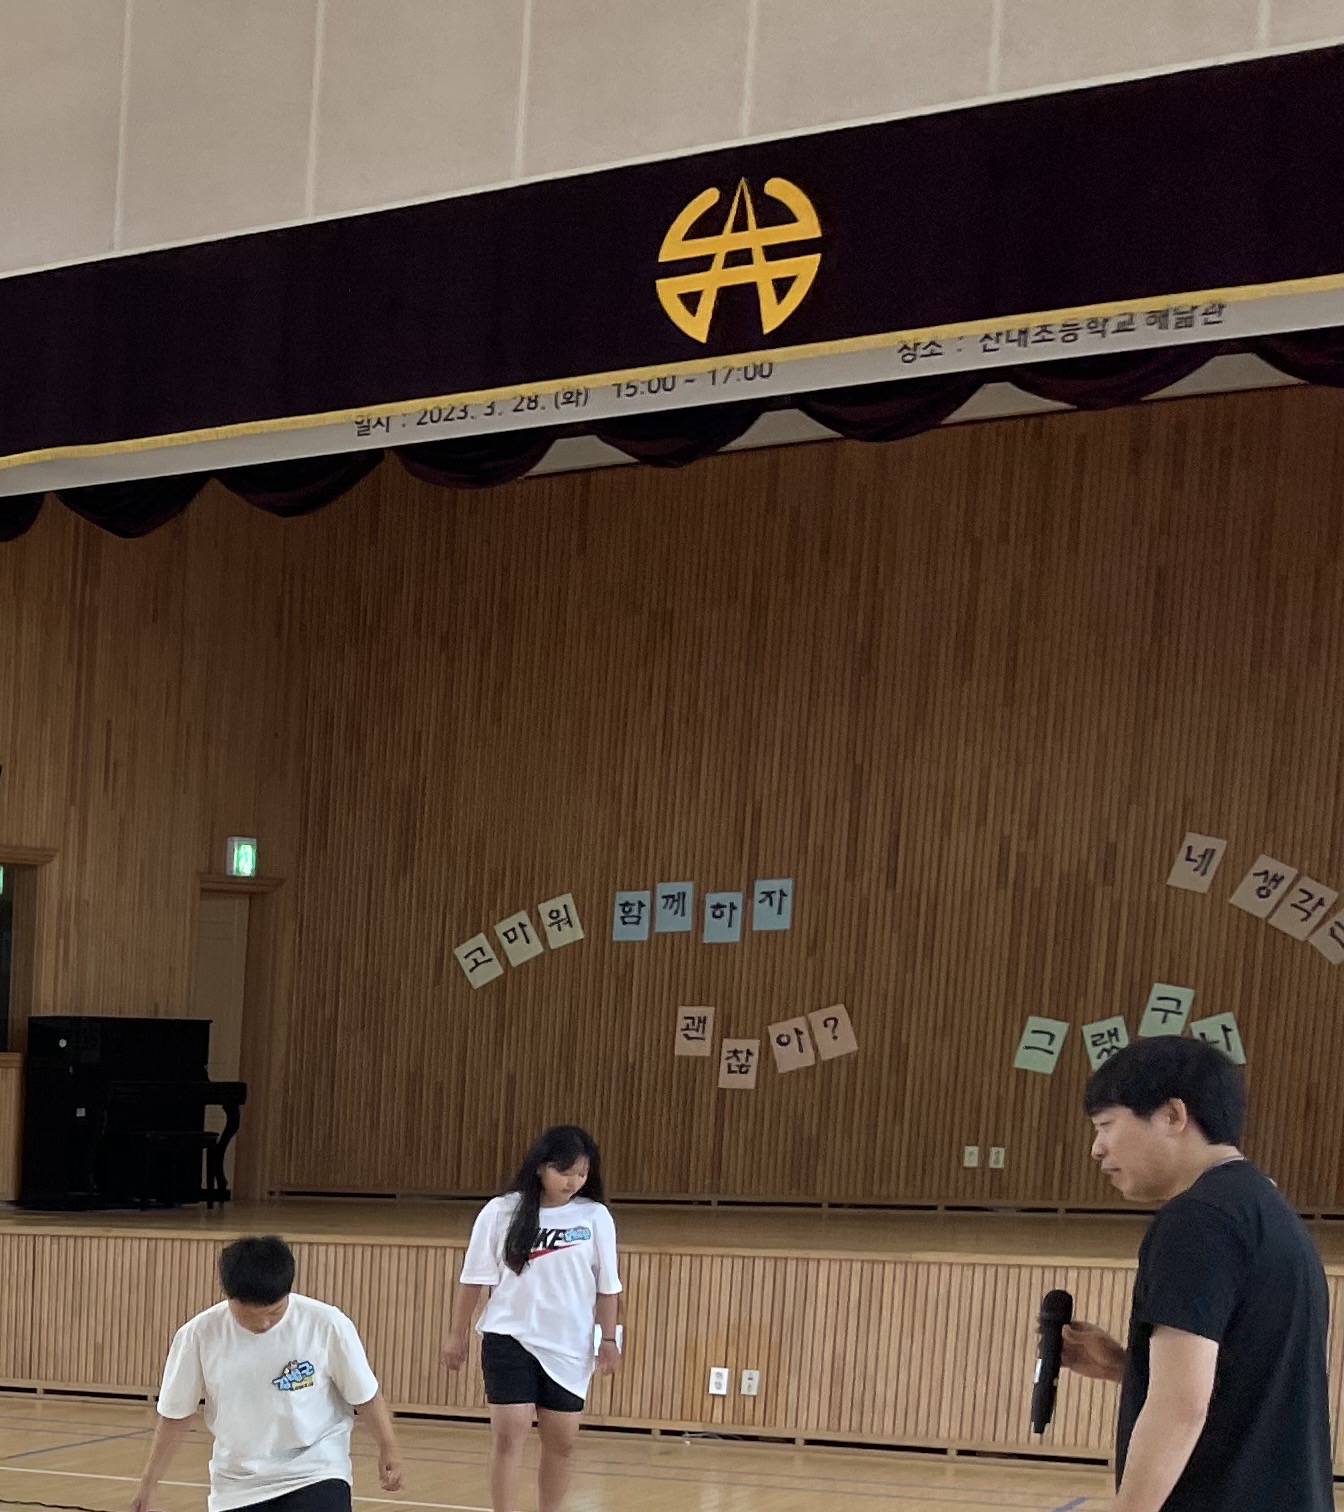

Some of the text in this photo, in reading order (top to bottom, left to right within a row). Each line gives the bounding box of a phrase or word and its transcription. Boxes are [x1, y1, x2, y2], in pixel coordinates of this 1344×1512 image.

[355, 415, 390, 437] 일시
[416, 403, 476, 426] 2023.
[513, 394, 546, 413] 28.
[555, 387, 589, 410] (화)
[1185, 845, 1216, 877] 네
[463, 904, 574, 974] 고마워
[680, 1015, 839, 1075] 괜찮아?
